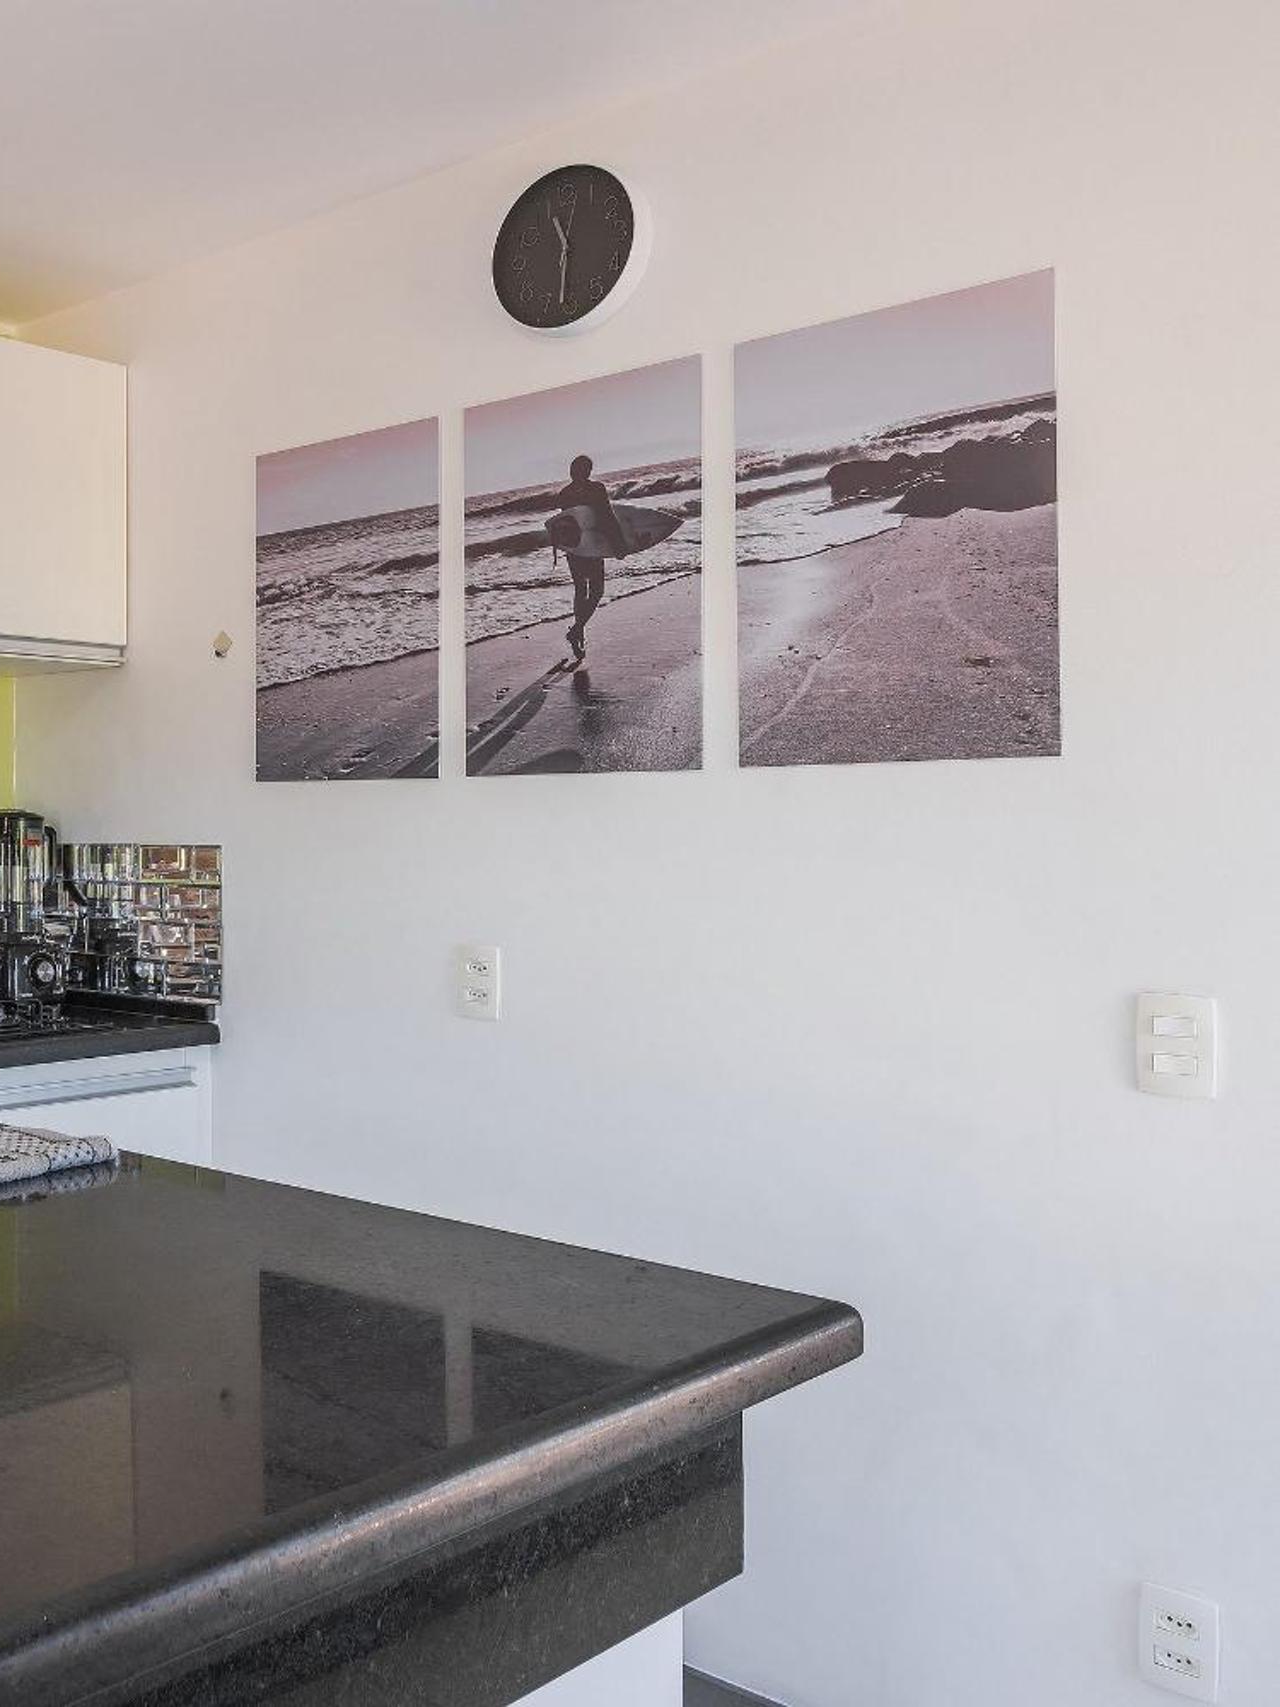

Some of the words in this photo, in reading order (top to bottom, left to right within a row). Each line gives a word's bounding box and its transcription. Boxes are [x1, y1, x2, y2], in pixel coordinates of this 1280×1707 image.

[557, 184, 577, 207] 12
[604, 194, 618, 219] 2
[607, 250, 620, 271] 4
[521, 279, 534, 302] 8
[589, 275, 604, 300] 5
[537, 293, 553, 314] 7
